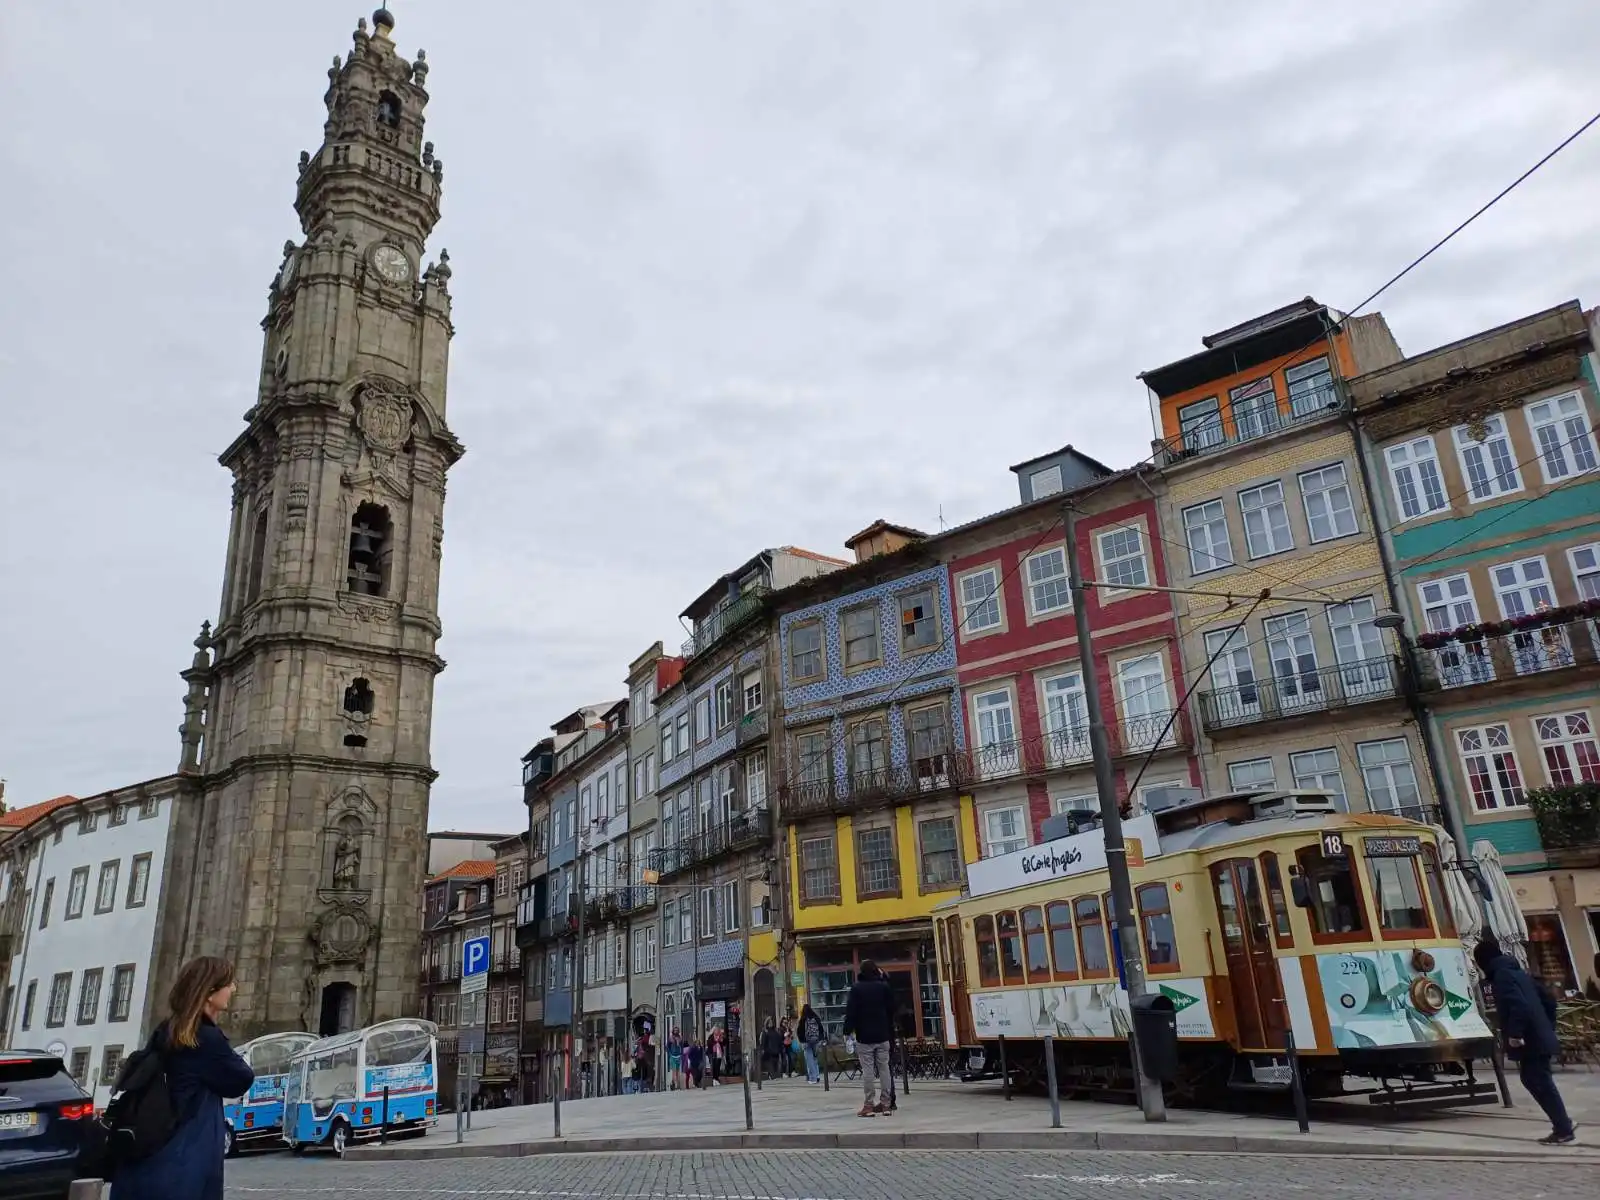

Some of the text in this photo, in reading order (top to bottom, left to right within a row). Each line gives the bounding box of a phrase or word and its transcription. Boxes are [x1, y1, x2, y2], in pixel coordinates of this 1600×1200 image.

[1325, 836, 1342, 854] 18
[1022, 847, 1081, 874] El Corte Inglés
[469, 943, 483, 973] P
[1341, 961, 1367, 975] 220
